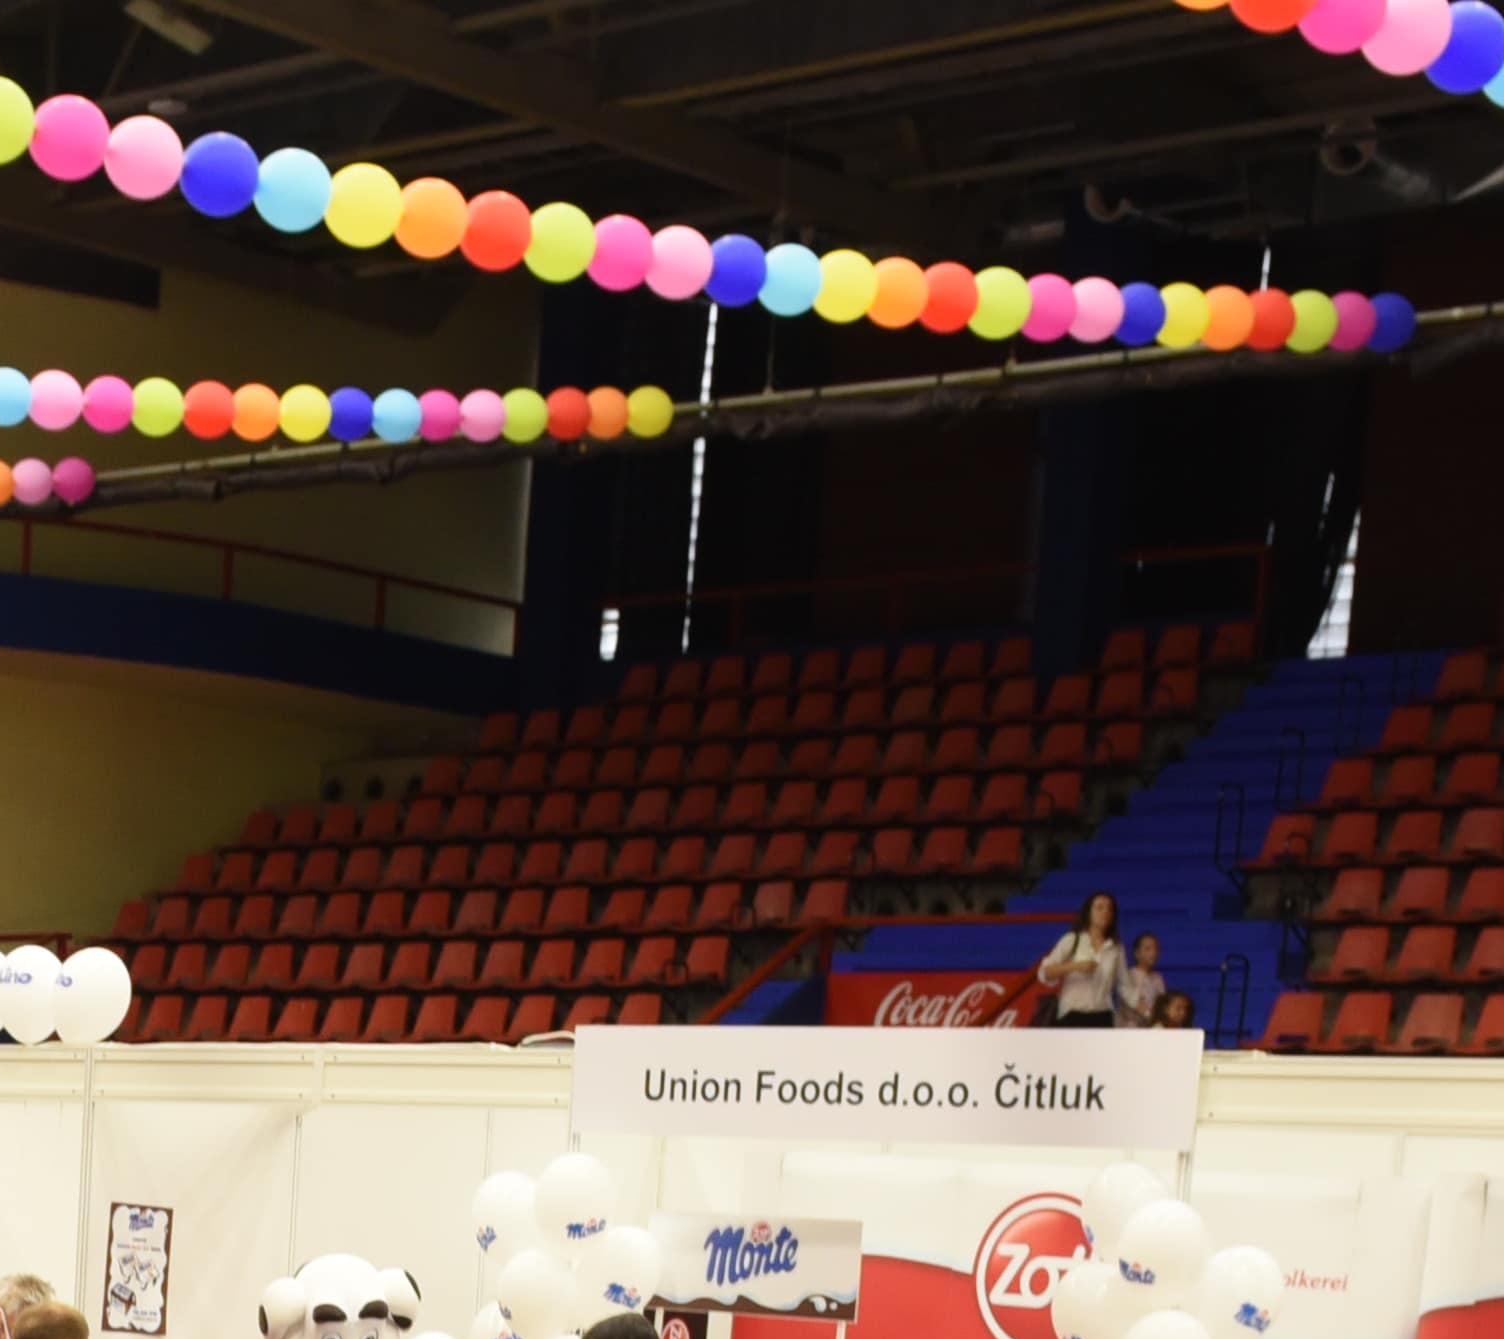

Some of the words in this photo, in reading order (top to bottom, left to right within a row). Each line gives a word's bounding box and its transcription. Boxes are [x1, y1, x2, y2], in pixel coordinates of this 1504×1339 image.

[643, 1068, 743, 1104] Union
[755, 1070, 865, 1106] Foods
[878, 1072, 979, 1108] d.o.o.
[995, 1063, 1106, 1112] Čitluk
[704, 1222, 800, 1287] Monte
